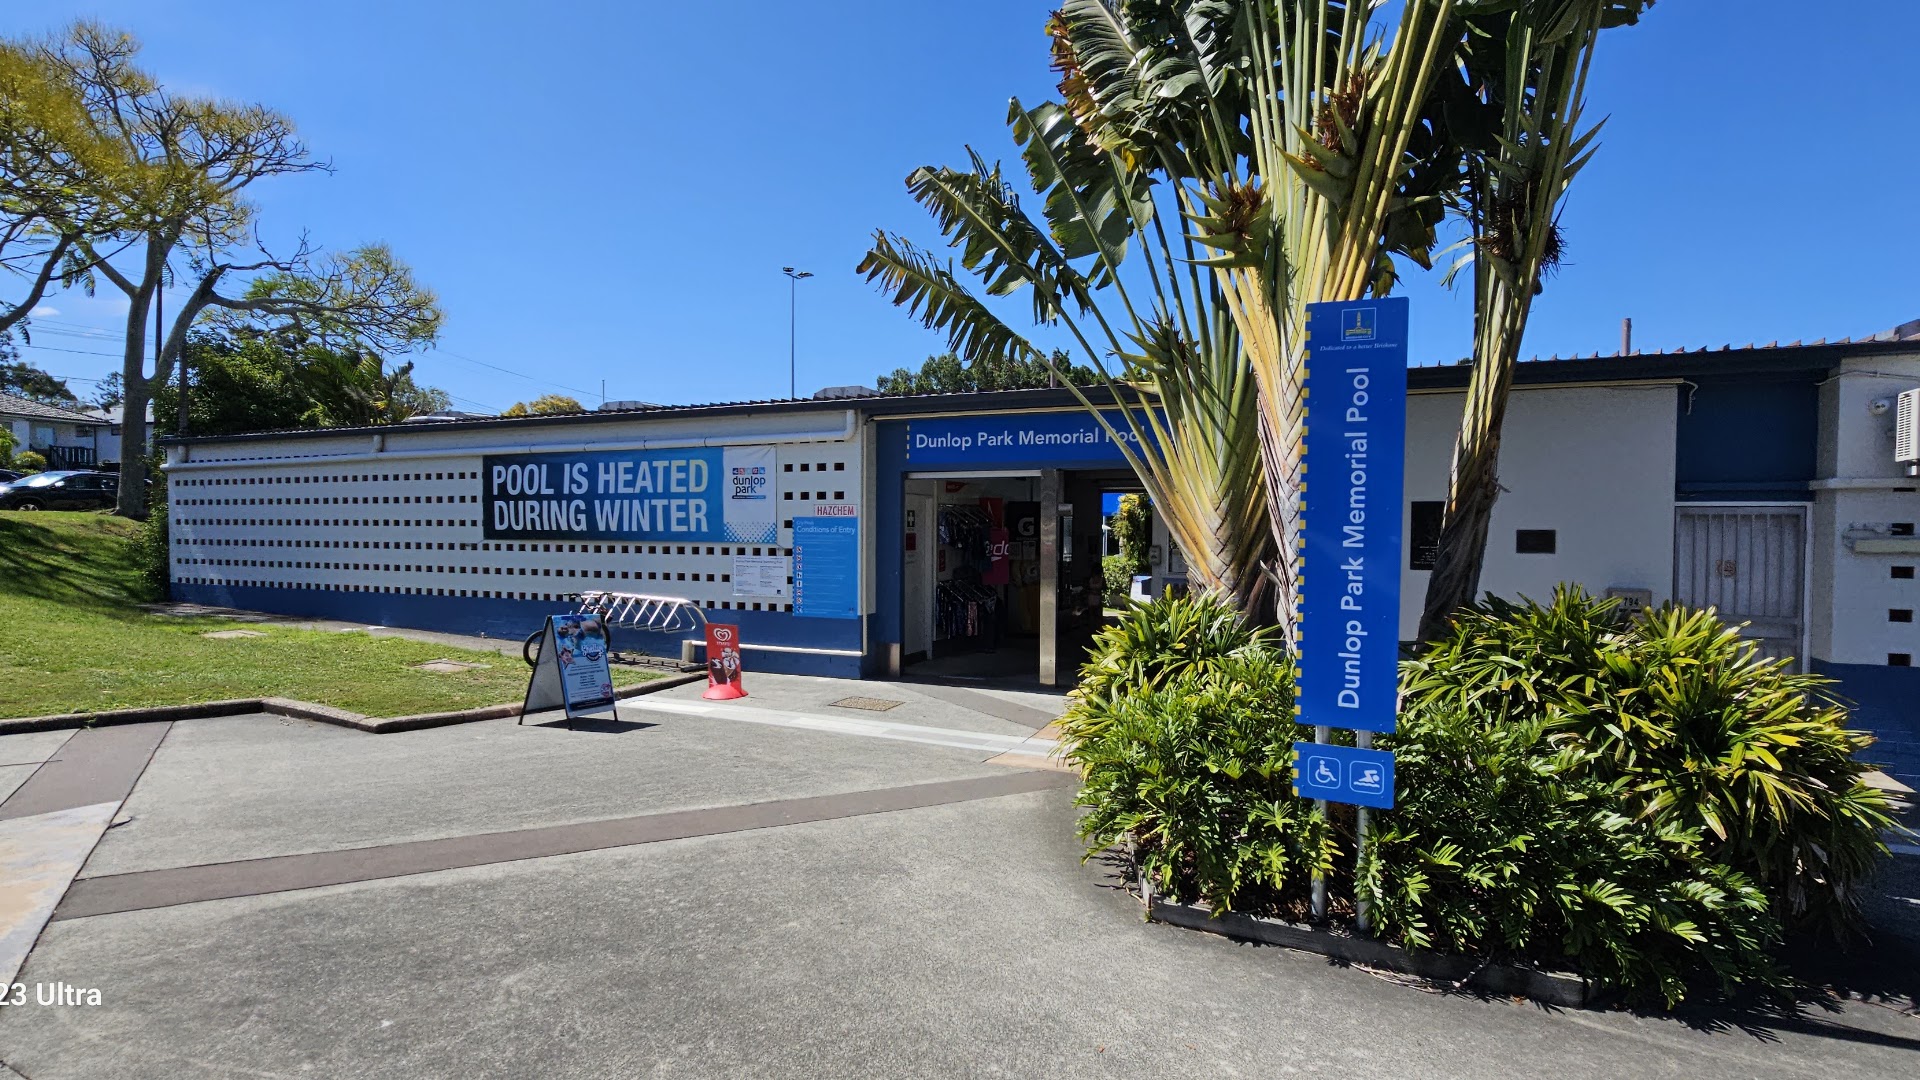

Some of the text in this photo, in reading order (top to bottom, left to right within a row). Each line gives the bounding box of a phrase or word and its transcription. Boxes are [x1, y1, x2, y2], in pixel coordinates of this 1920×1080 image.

[1320, 344, 1346, 352] Dedicated
[916, 432, 972, 451] Dunlop
[977, 430, 1013, 447] Park
[1018, 427, 1099, 446] Memorial
[492, 459, 709, 496] POOL IS HEATED
[732, 475, 766, 488] dunlop
[735, 485, 757, 496] park
[493, 498, 709, 533] DURING WINTER
[817, 505, 855, 516] HAZCHEM
[796, 525, 856, 535] Conditions of Entry
[1337, 367, 1370, 709] Dunlop Park Memorial Pool
[1624, 597, 1639, 607] 794
